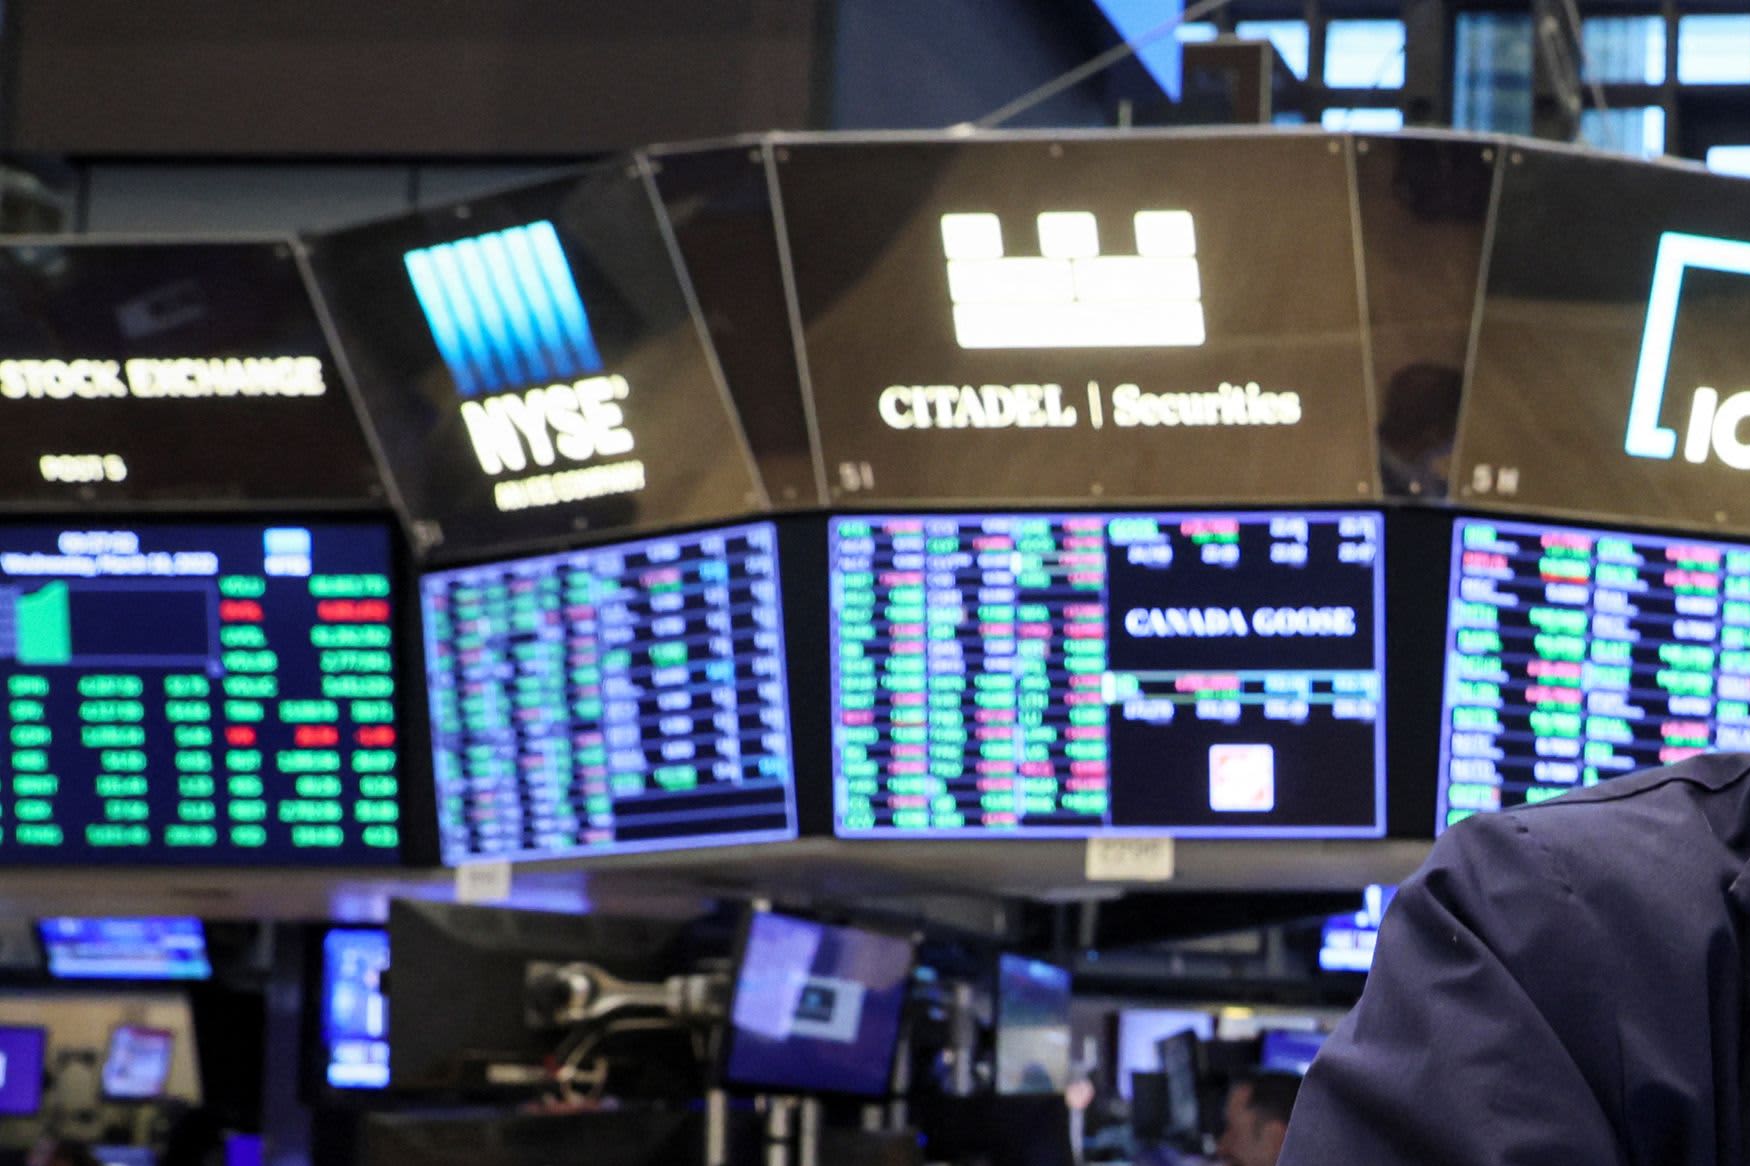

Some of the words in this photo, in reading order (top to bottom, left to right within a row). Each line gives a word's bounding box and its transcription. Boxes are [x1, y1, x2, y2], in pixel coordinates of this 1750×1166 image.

[0, 358, 128, 399] STOCK
[461, 374, 635, 476] NYSE
[879, 384, 1078, 430] CITADEL
[1112, 381, 1302, 428] Securities
[1125, 607, 1249, 638] CANADA
[1252, 606, 1357, 638] GOOSE
